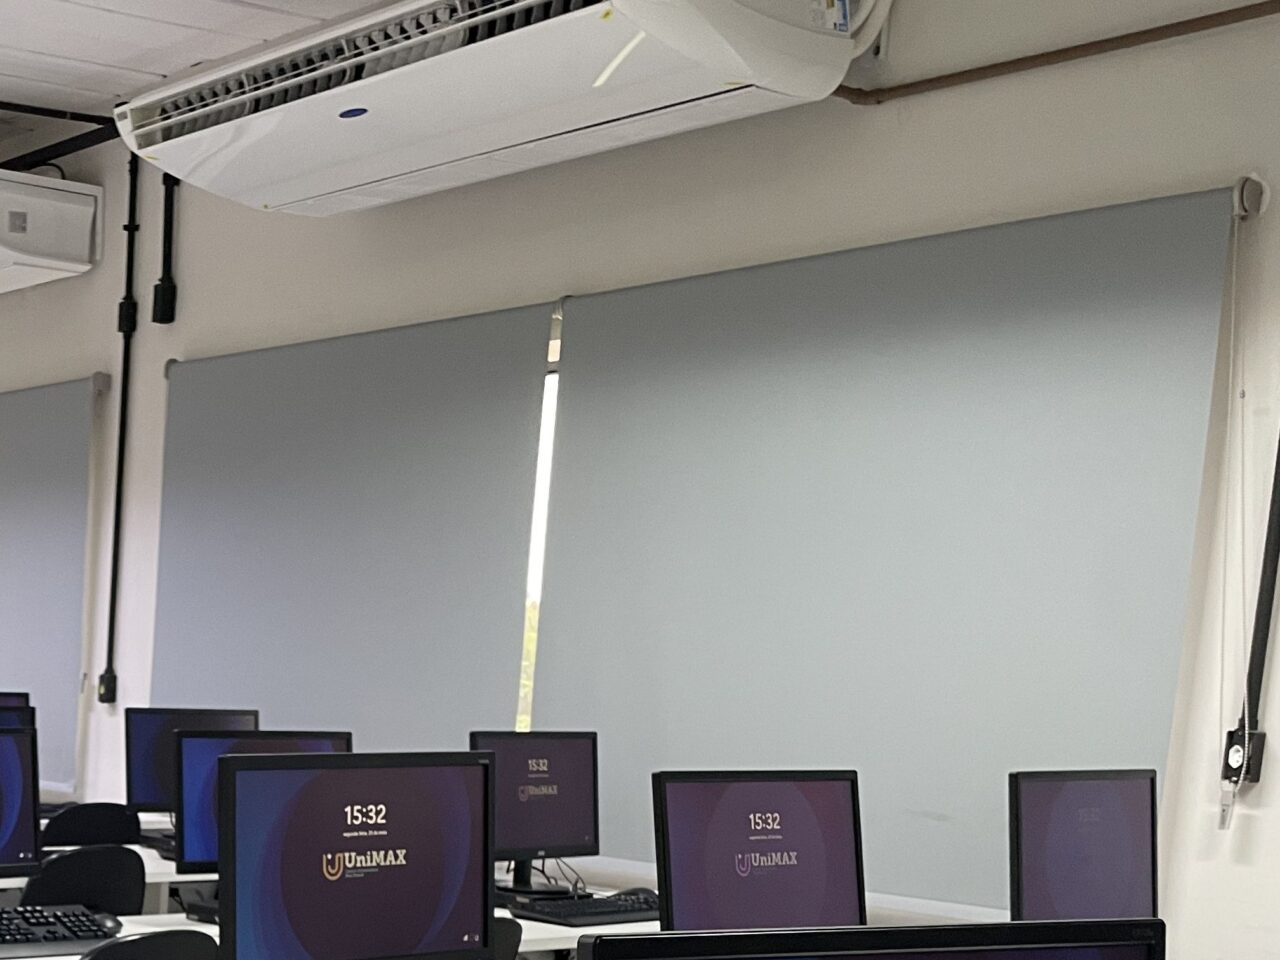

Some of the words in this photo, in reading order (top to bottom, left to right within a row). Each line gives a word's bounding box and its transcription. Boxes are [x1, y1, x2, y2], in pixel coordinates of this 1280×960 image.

[344, 804, 386, 825] 15:32
[749, 812, 781, 830] 15:32
[344, 849, 406, 868] UniMAX
[751, 851, 798, 866] UniMAX
